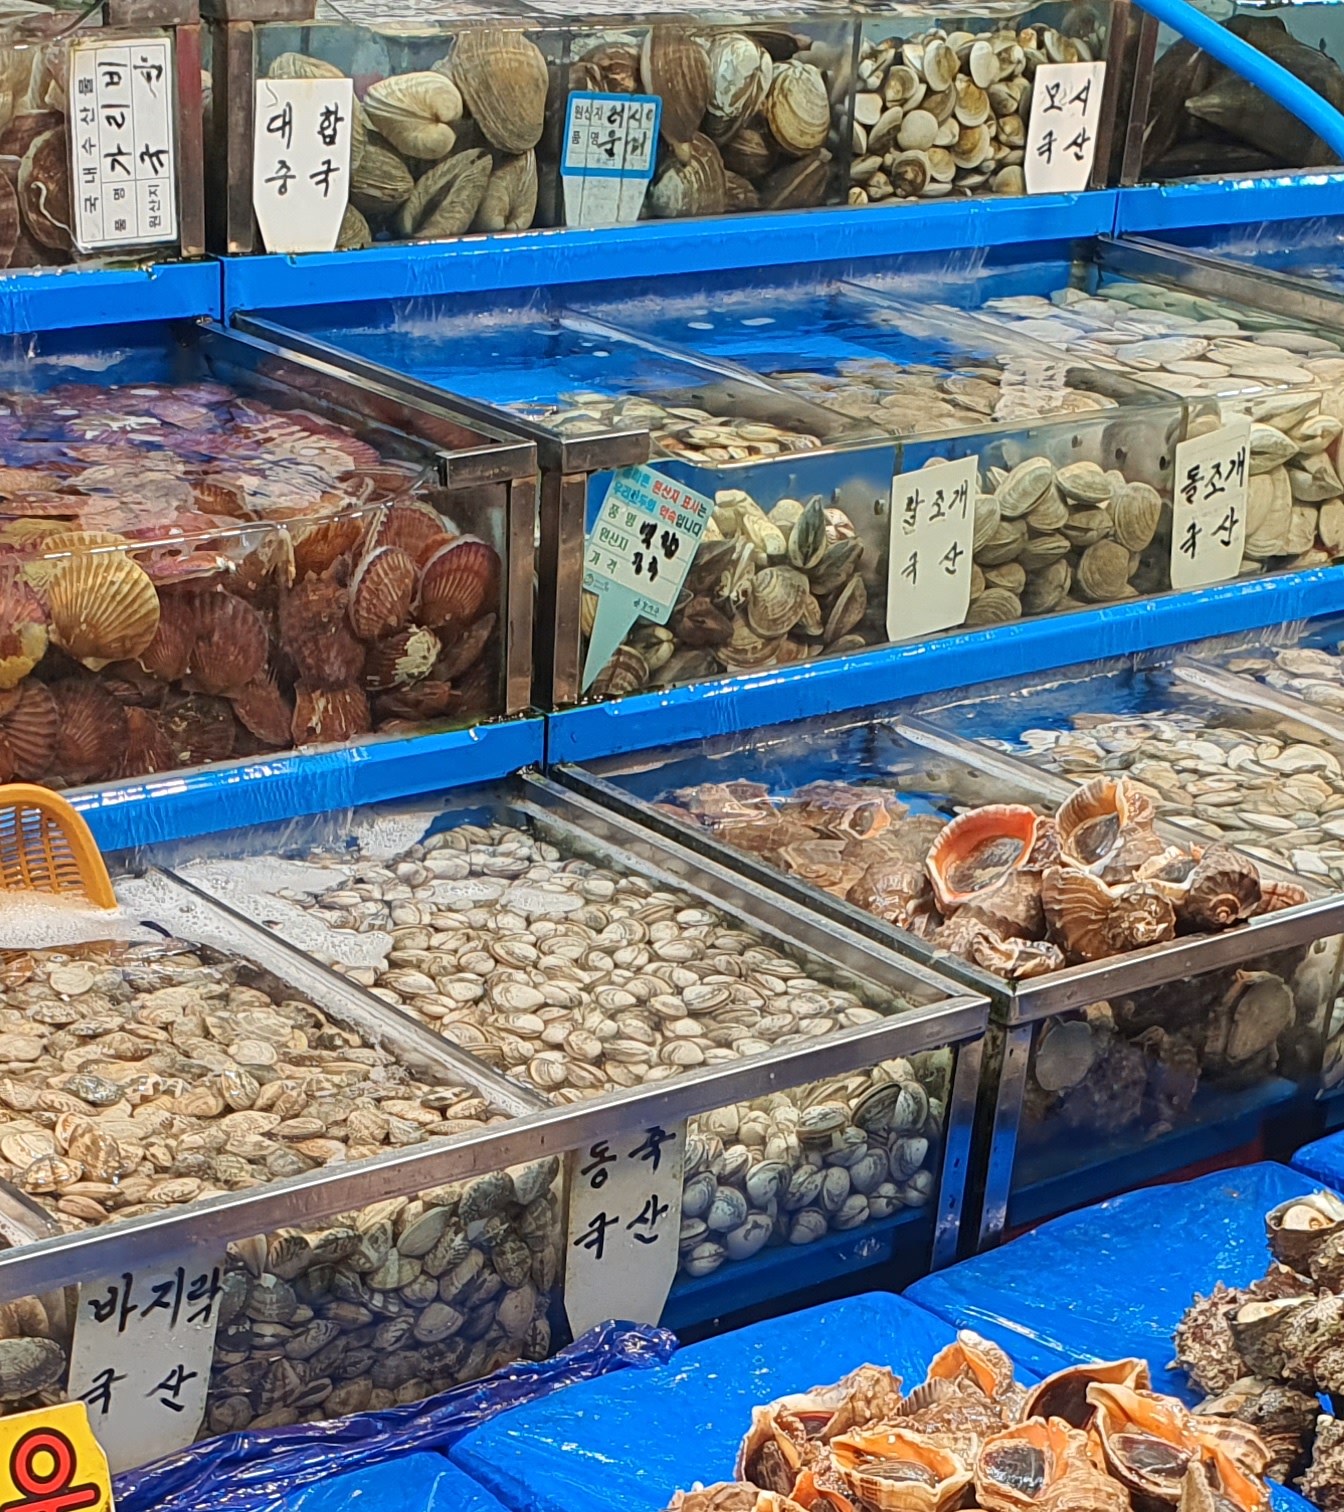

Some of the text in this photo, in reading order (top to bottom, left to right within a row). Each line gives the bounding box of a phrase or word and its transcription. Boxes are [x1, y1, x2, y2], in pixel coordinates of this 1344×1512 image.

[98, 62, 132, 176] 가리비
[148, 184, 161, 228] 원산지
[1180, 445, 1247, 505] 돌조개
[652, 479, 681, 504] 원산지
[680, 494, 707, 519] 표시는
[659, 505, 703, 537] 약속입니다
[598, 526, 629, 552] 원산지
[87, 1266, 223, 1333] 바지락
